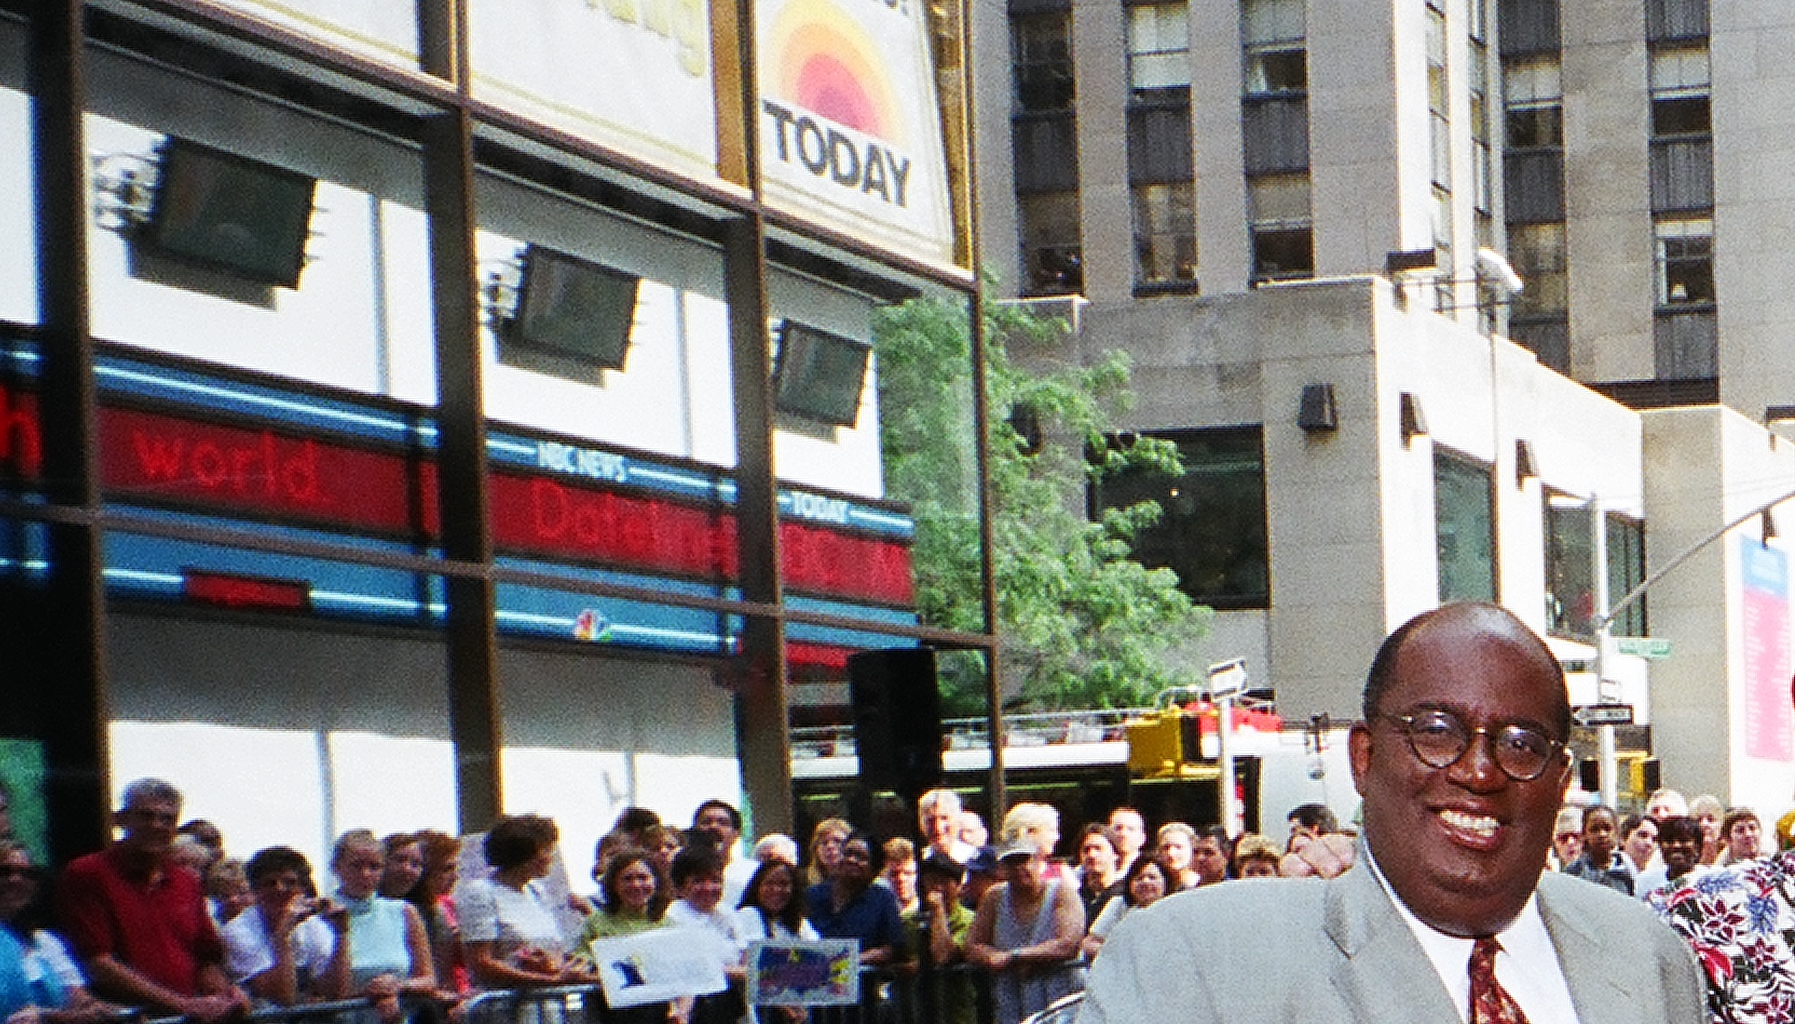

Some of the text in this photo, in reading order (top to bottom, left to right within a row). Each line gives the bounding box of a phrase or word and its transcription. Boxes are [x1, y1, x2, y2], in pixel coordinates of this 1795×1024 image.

[762, 101, 910, 206] TODAY
[133, 428, 318, 501] world
[538, 444, 627, 480] NBC NEWS
[792, 492, 850, 522] TODAY
